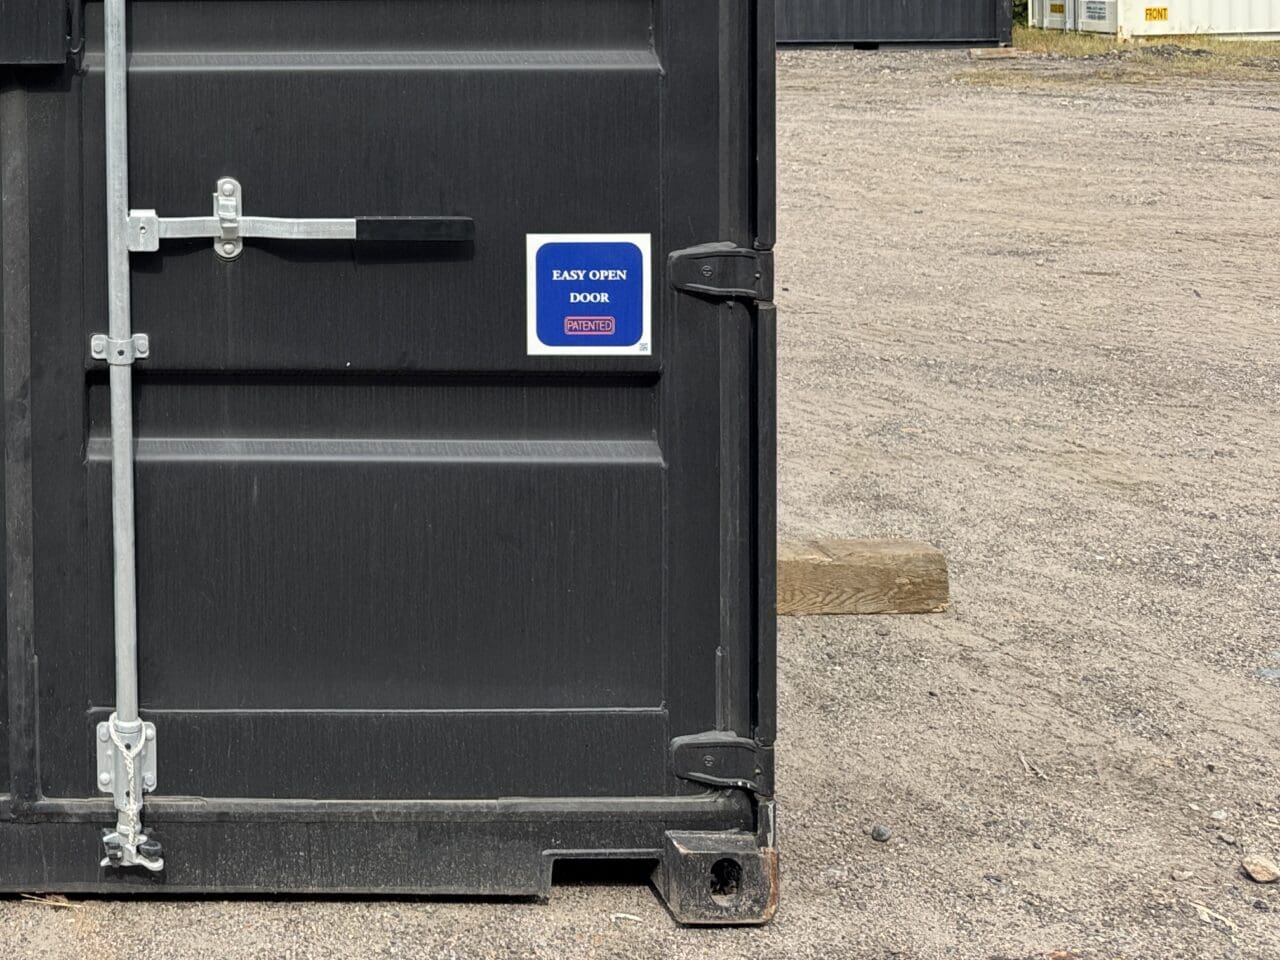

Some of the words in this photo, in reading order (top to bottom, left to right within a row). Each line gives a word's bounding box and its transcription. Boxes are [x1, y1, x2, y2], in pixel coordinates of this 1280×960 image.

[1145, 7, 1168, 21] FRONT
[552, 270, 587, 280] EASY
[588, 270, 627, 280] OPEN
[569, 292, 610, 303] DOOR
[567, 320, 612, 331] PATENTED
